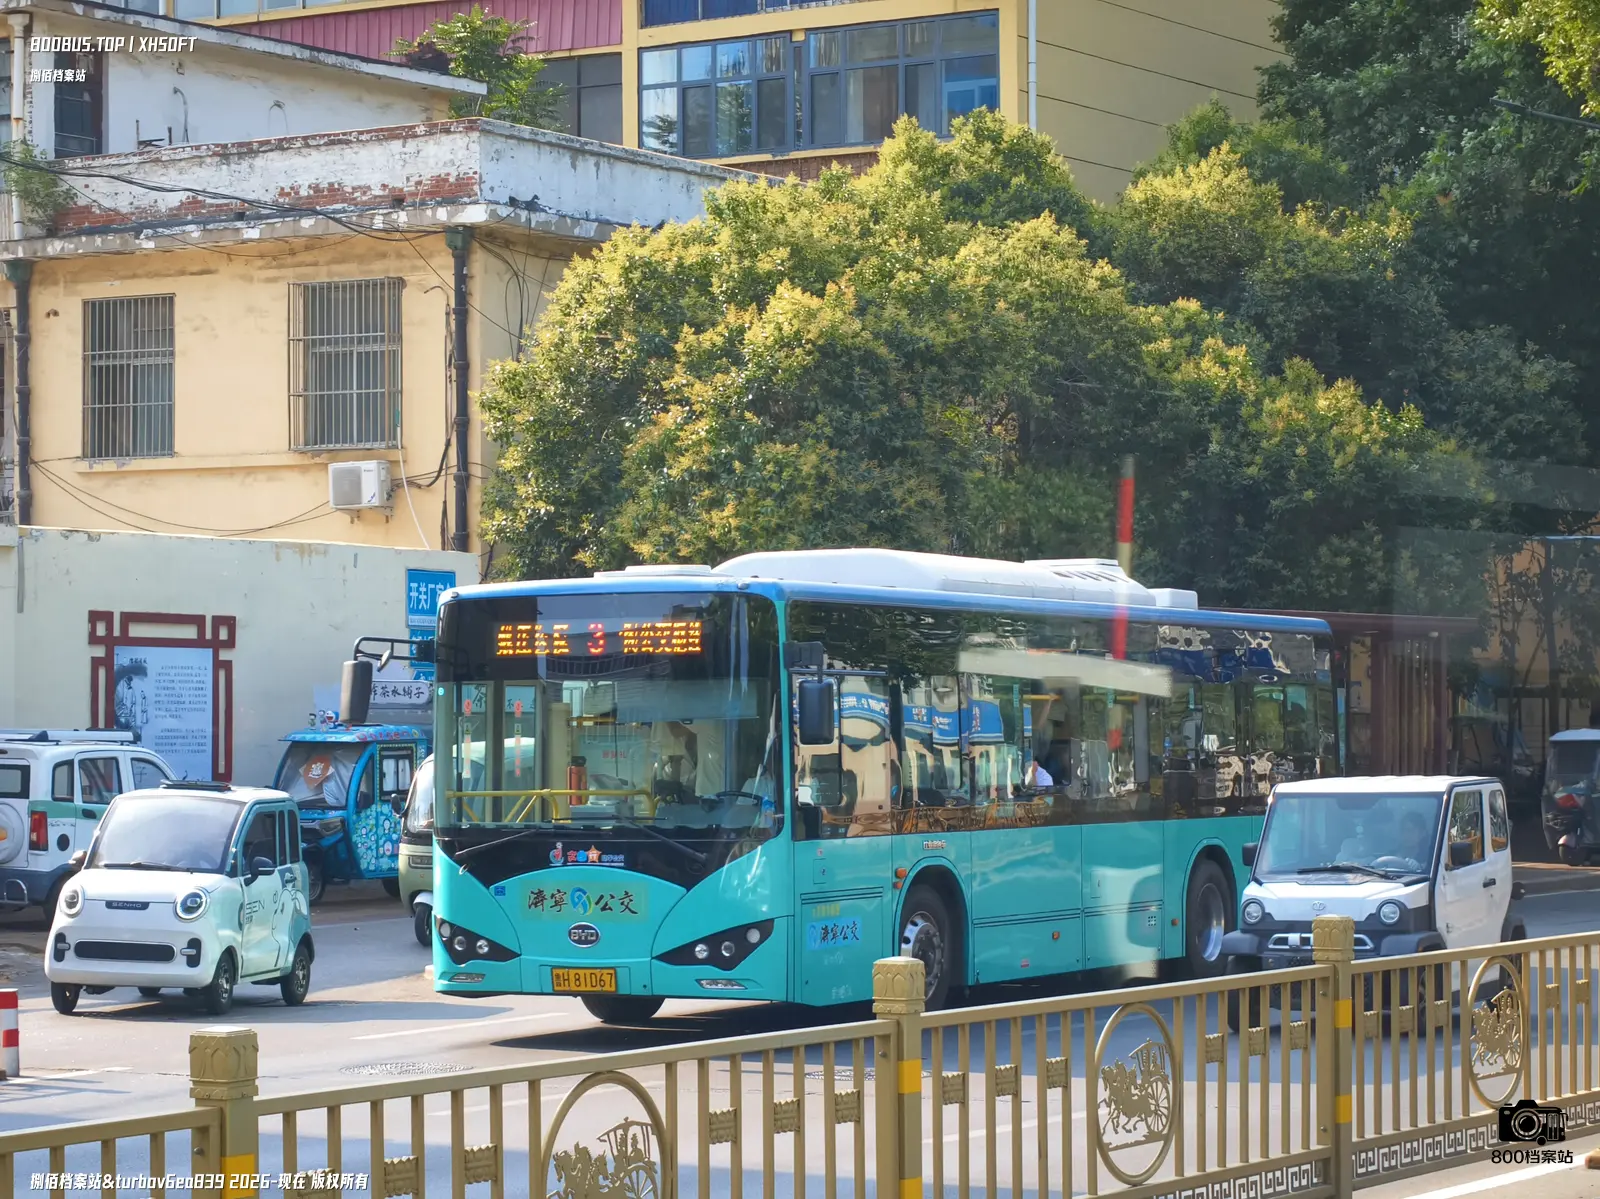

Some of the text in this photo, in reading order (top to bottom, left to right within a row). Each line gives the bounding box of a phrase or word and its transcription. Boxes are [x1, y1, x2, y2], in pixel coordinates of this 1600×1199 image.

[410, 582, 450, 610] 开关厂
[588, 623, 605, 656] 3
[595, 891, 638, 915] 公交
[570, 930, 596, 940] BYD
